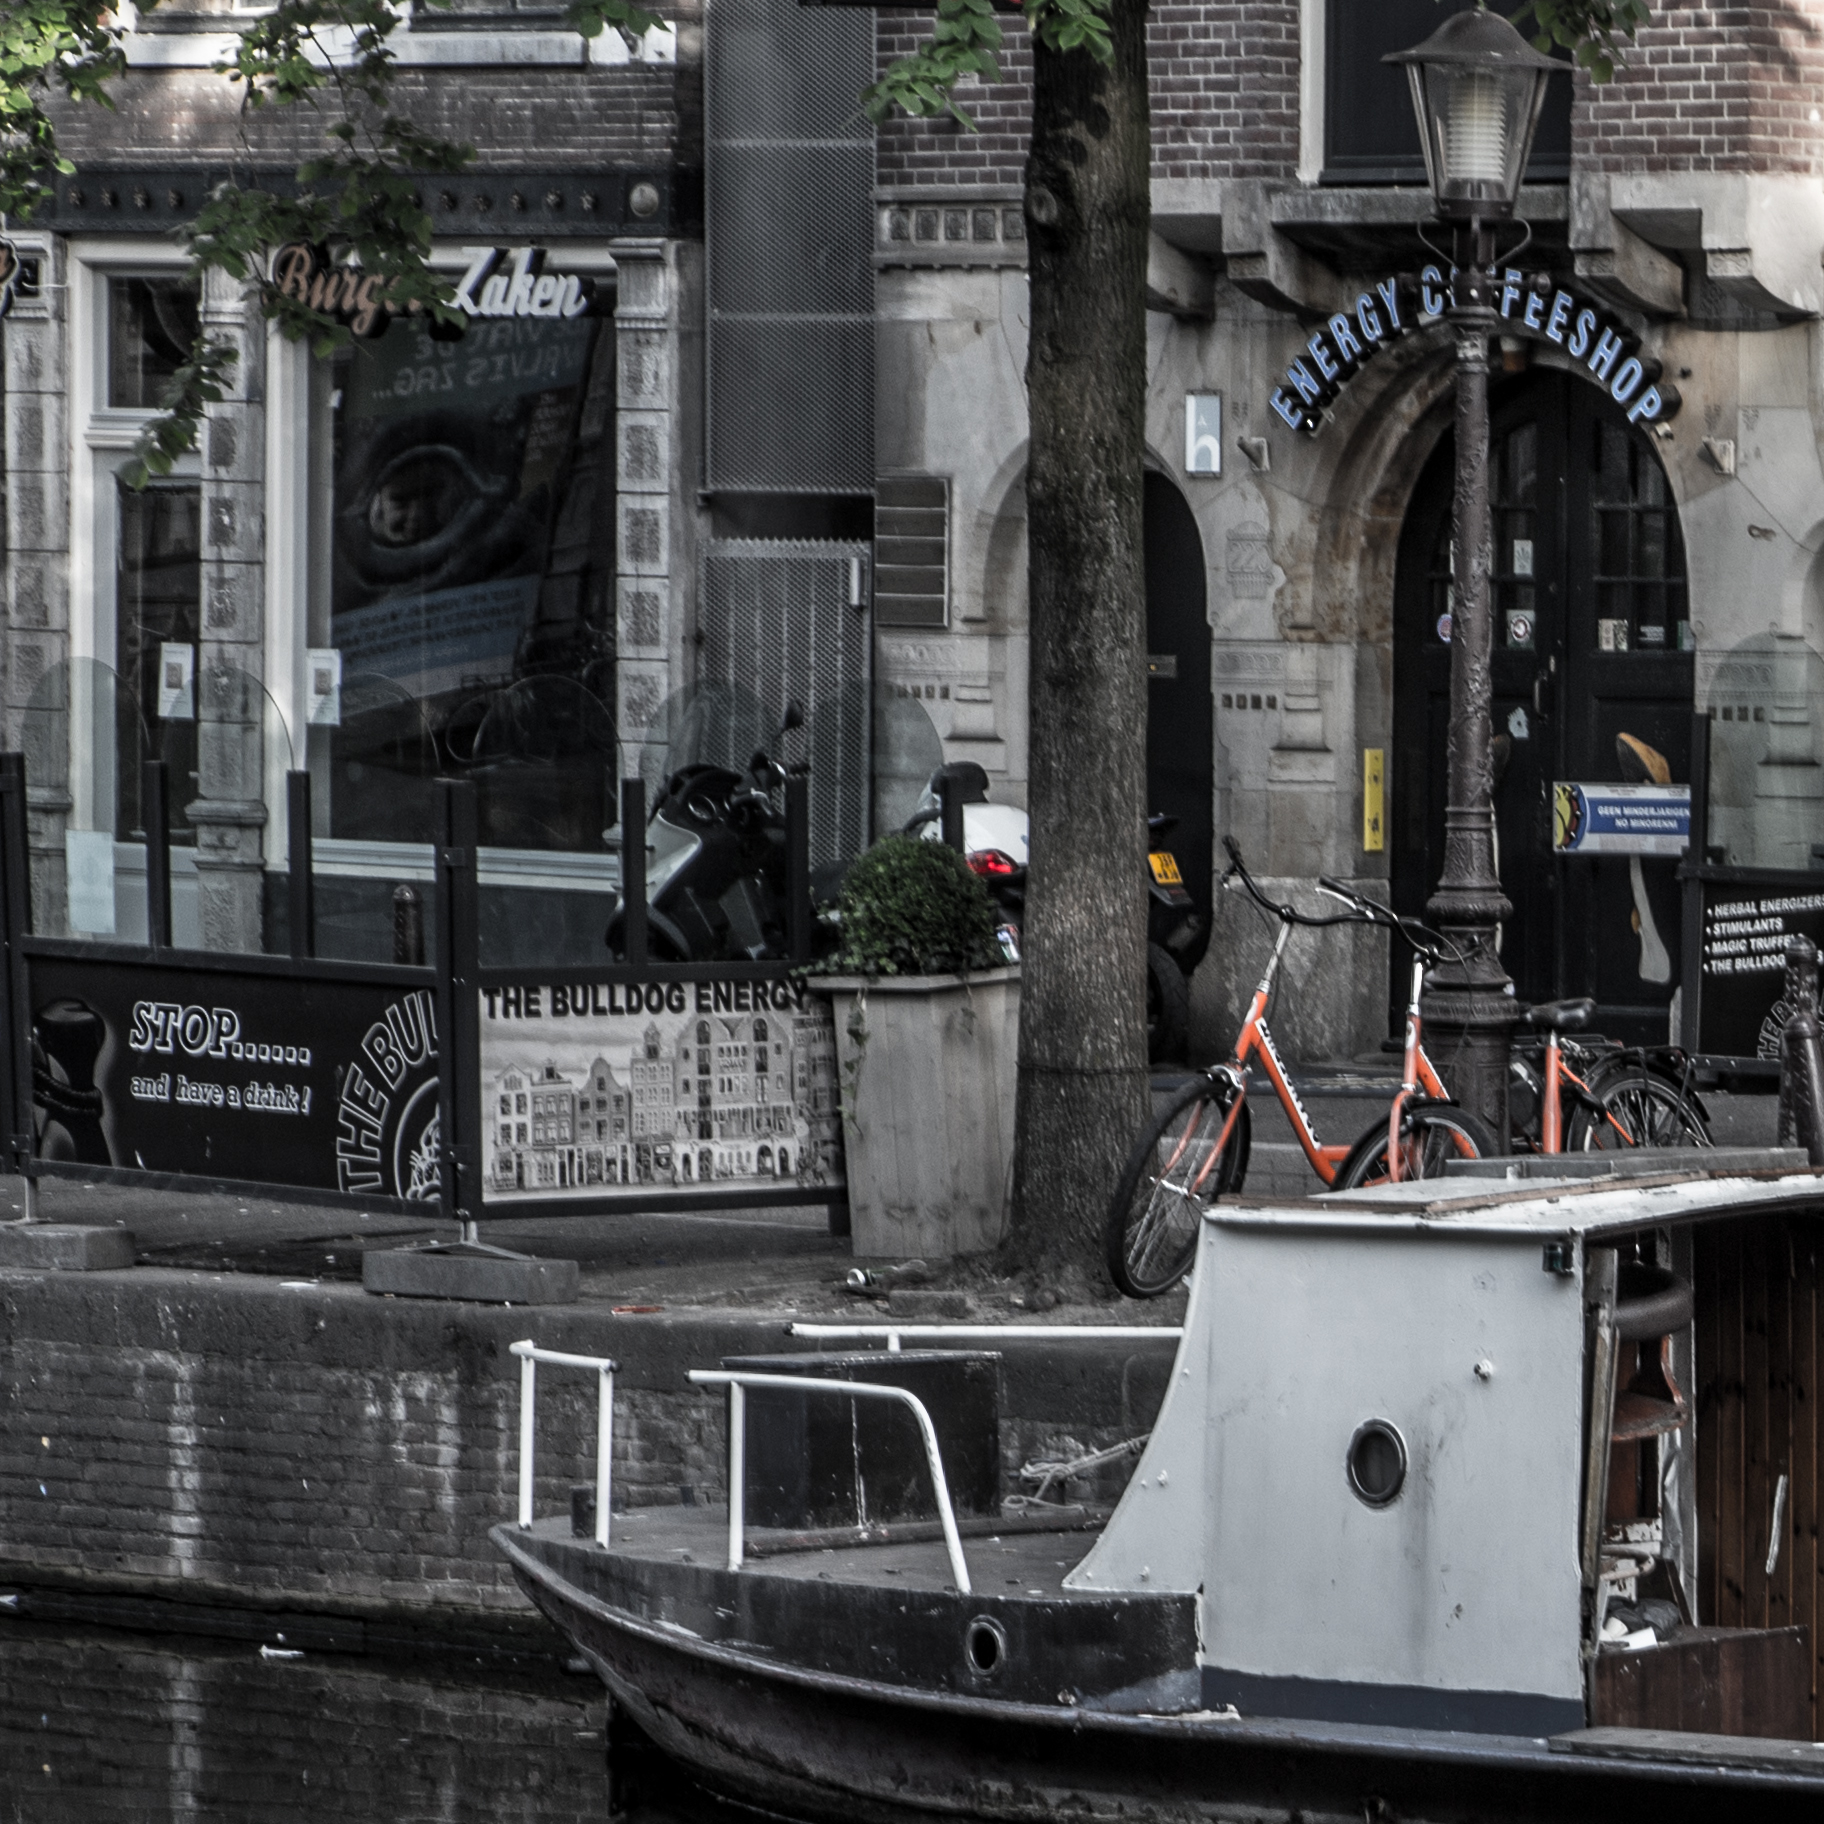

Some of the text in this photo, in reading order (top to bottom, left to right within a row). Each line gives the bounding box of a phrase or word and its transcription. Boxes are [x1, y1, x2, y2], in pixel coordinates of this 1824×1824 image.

[273, 244, 588, 336] Burg Zaken
[1269, 263, 1662, 430] ENERGY CFEESHOP
[1597, 804, 1622, 817] GEEN
[1615, 817, 1629, 828] NO
[1714, 900, 1759, 918] HERBAL
[1713, 917, 1784, 936] STIMULANTS
[1711, 933, 1796, 956] MAGIC TRUFFE
[1710, 953, 1787, 976] THE BULLDOG
[483, 979, 804, 1019] THE BULLDOG ENERGY
[131, 1073, 171, 1102] and
[176, 1074, 223, 1106] have
[226, 1085, 241, 1109] a
[336, 1062, 390, 1193] THE
